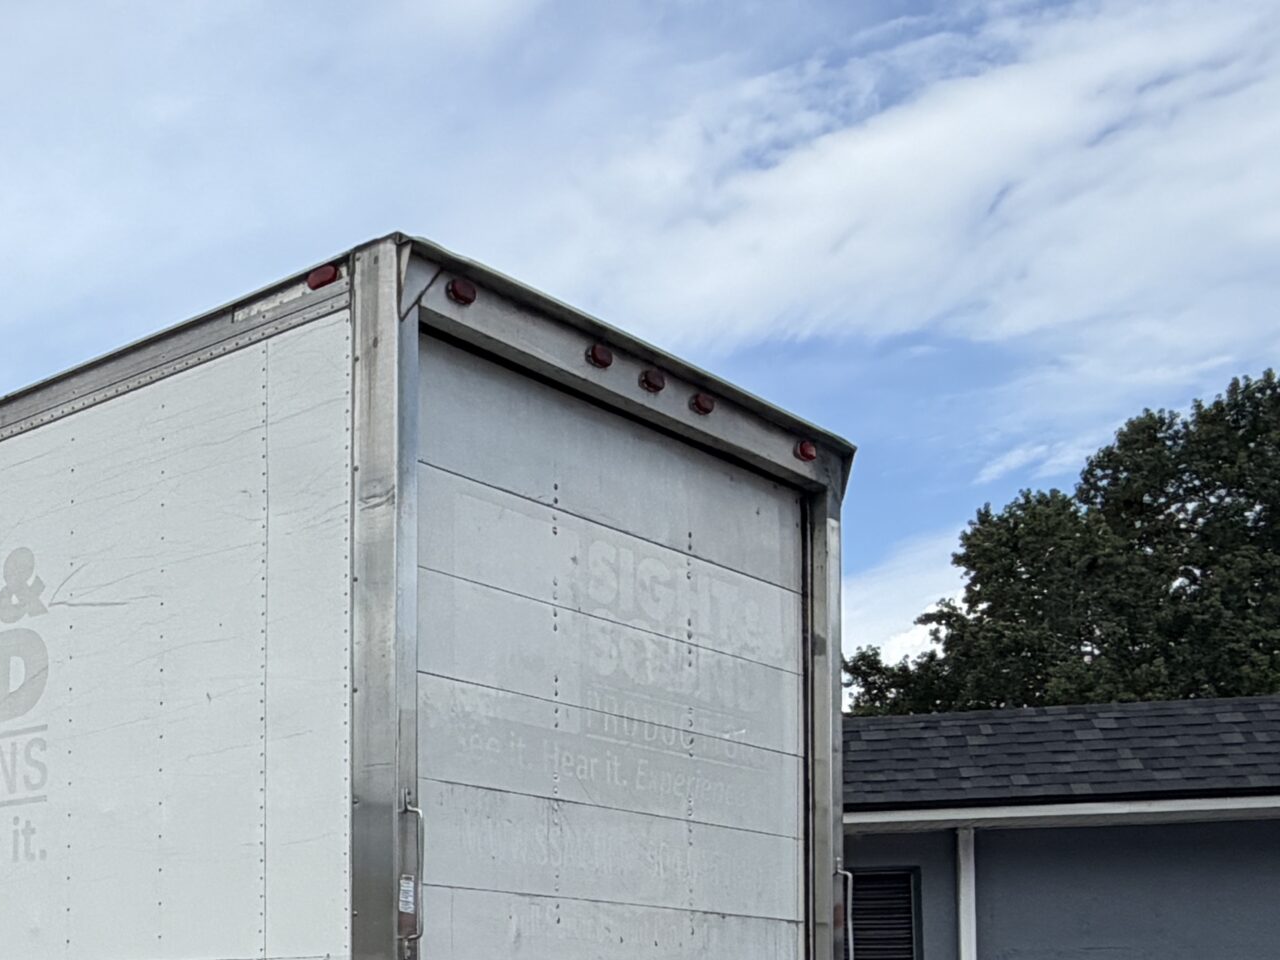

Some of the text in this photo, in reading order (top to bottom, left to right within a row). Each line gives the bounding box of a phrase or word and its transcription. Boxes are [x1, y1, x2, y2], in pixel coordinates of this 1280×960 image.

[588, 535, 739, 643] SIGHT
[543, 737, 598, 782] Hear
[605, 749, 627, 787] it.
[12, 816, 48, 862] it.
